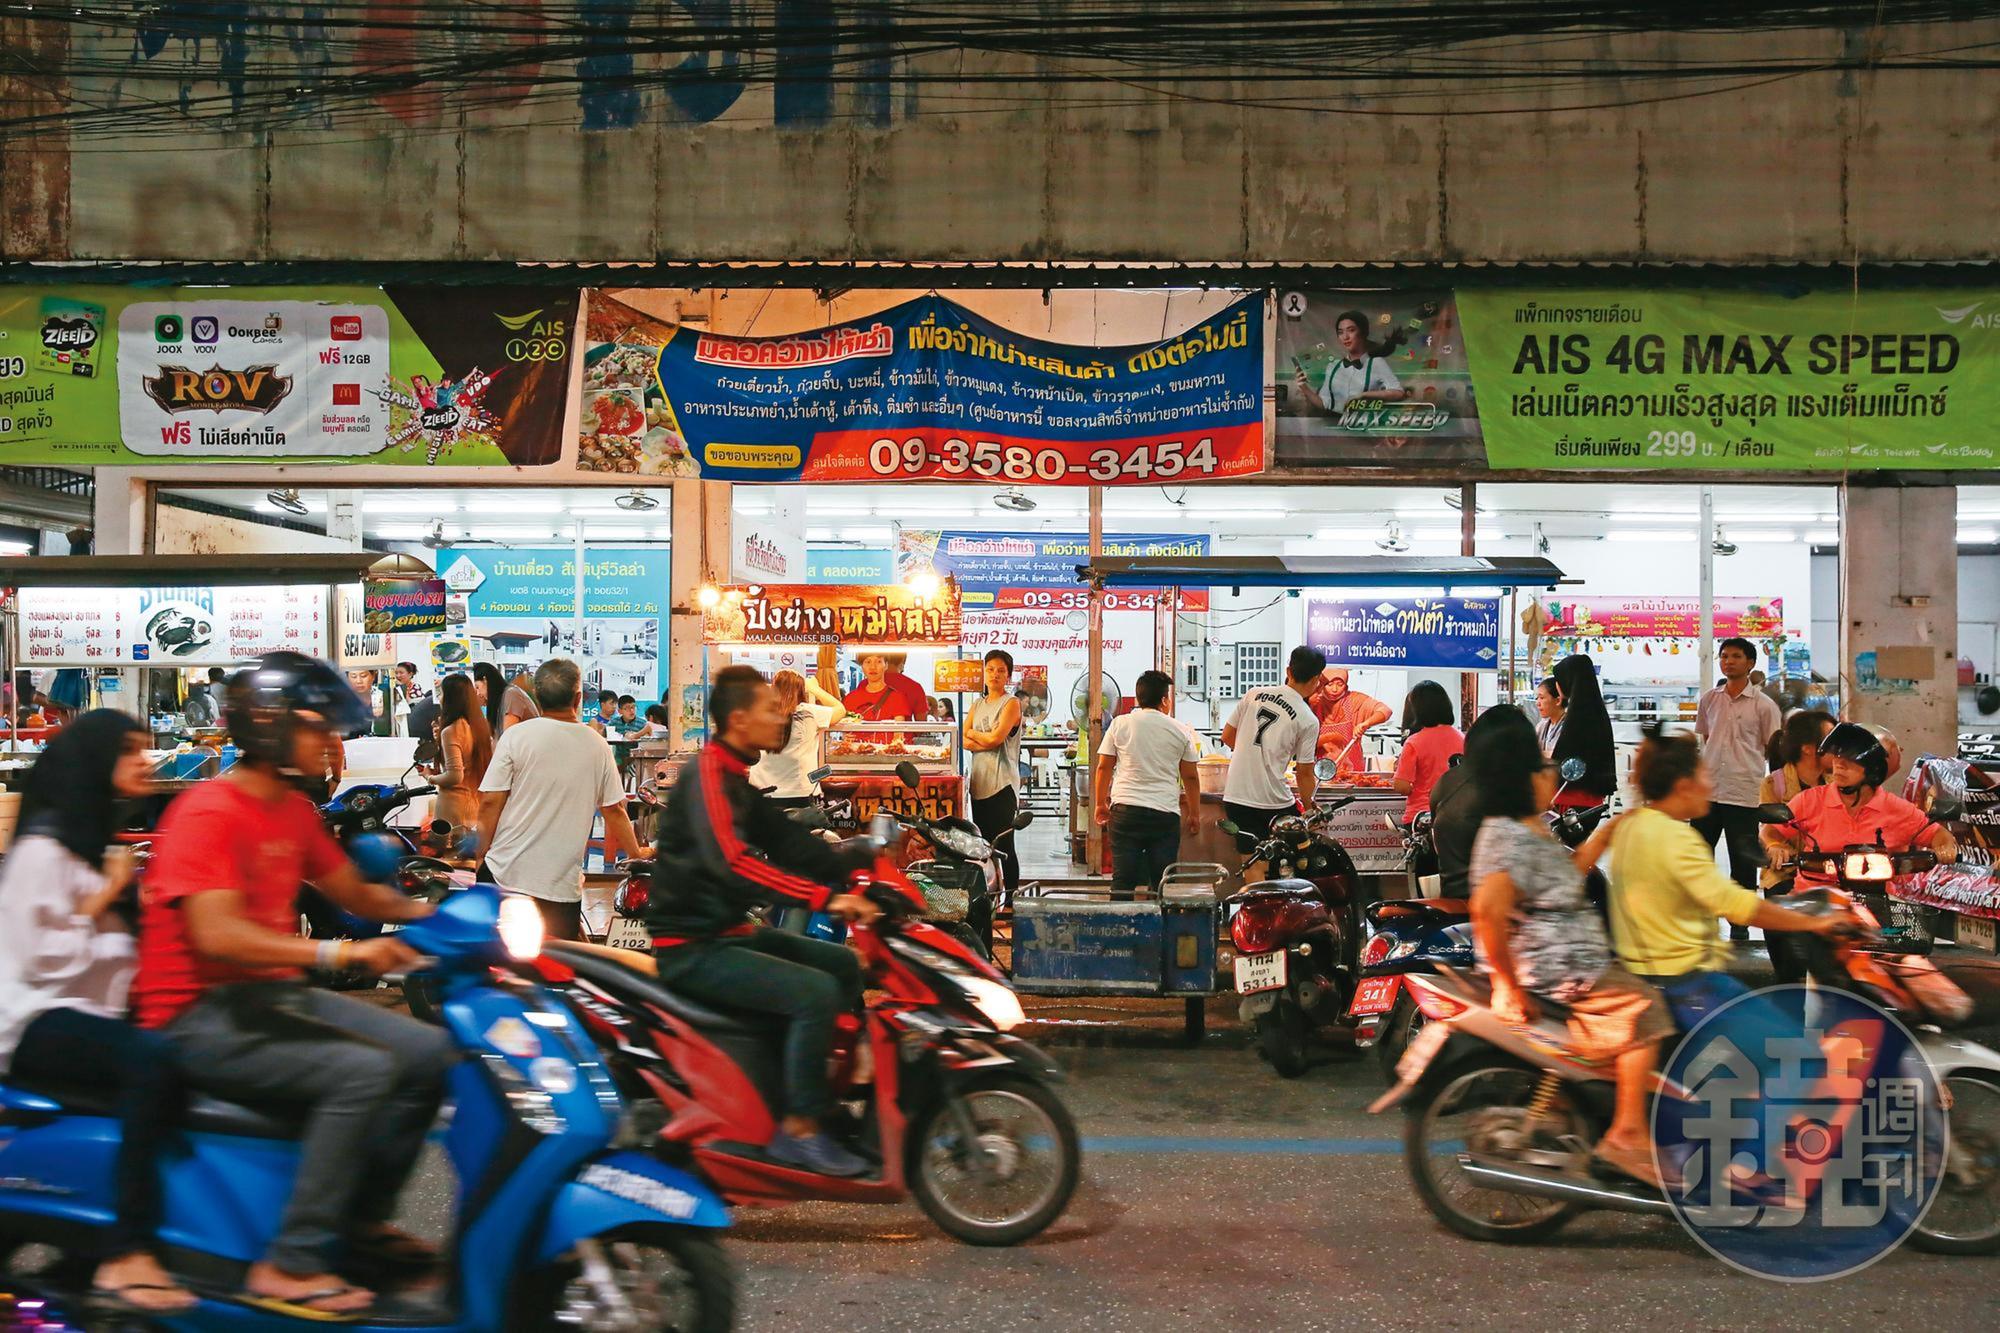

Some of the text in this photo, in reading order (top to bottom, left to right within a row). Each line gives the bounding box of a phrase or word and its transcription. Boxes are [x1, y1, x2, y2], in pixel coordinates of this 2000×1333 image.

[1515, 303, 1642, 324] แพ็กเกจรายเดือน
[531, 321, 565, 336] AIS
[157, 346, 182, 354] JOOX
[194, 346, 217, 354] VOOV
[319, 348, 371, 365] ฟรี 12GB
[1512, 334, 1960, 375] AIS 4G MAX SPEED
[466, 376, 491, 397] VDO
[1169, 373, 1226, 393] ขนมหวาน
[379, 388, 419, 410] GAME
[1512, 383, 1949, 428] เล่นเน็ตความเร็วสูงสุด แรงเต็มแม็กซ์
[17, 408, 53, 434] สุดขั้ว
[462, 418, 486, 432] EAT
[1338, 411, 1450, 426] MAX SPEED
[161, 420, 286, 446] ฟรี ไม่เสียค่าเน็ต
[1555, 437, 1641, 458] เริ่มต้นเพียง
[1647, 431, 1696, 456] 299
[1702, 443, 1717, 457] บ.
[1735, 438, 1774, 457] เดือน
[711, 449, 794, 466] ขอขอบพระคุณ
[869, 437, 1218, 482] 09-3580-3454
[494, 558, 554, 576] บ้านเดี่ยว
[823, 565, 881, 578] คลองหวะ
[490, 603, 531, 613] ห้องนอน
[548, 602, 575, 613] ห้องน้
[588, 602, 631, 613] จอดรถได้
[634, 605, 641, 613] 2
[645, 602, 658, 613] คัน
[962, 612, 1066, 626] นอาทิตย์ที่สามของเดือน
[1445, 613, 1497, 637] ข้าวหมกไก่
[345, 634, 359, 656] SEA
[361, 634, 380, 656] FOOD
[746, 634, 839, 643] MALA CHAINESE BBQ
[991, 630, 999, 645] 2
[1002, 629, 1019, 645] วัน
[1253, 705, 1281, 747] 7
[612, 939, 646, 947] 2102
[1243, 975, 1277, 992] 5311
[1362, 988, 1387, 1002] 341
